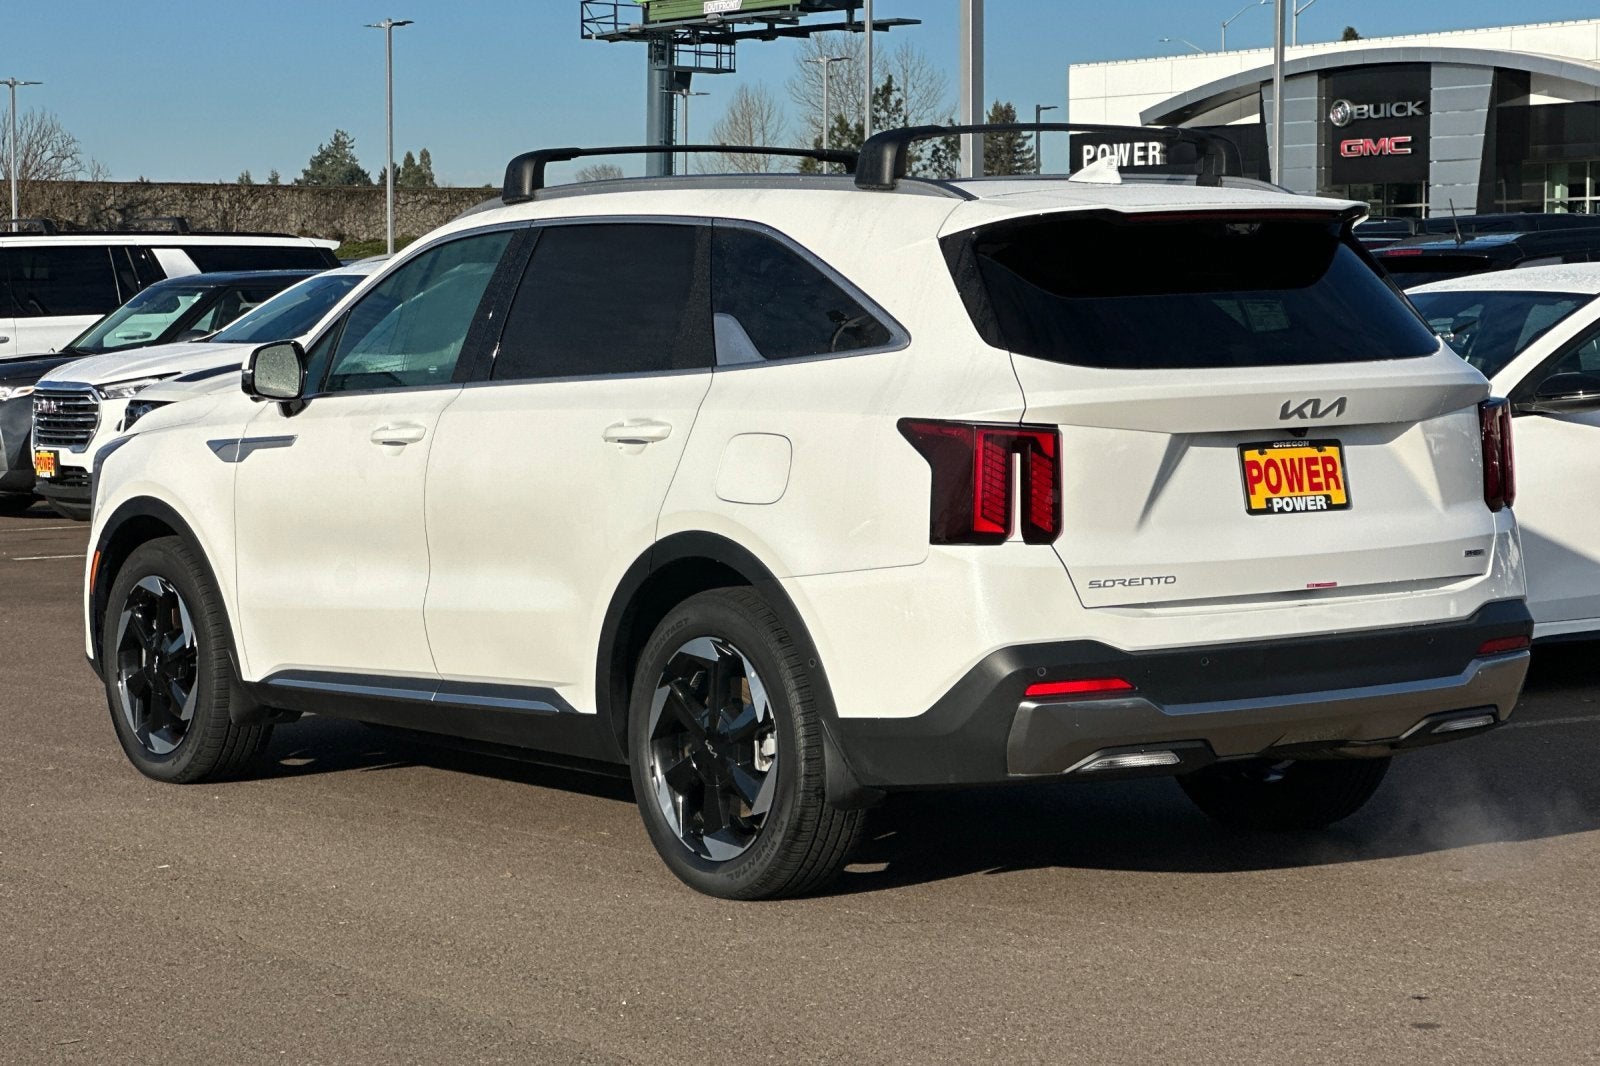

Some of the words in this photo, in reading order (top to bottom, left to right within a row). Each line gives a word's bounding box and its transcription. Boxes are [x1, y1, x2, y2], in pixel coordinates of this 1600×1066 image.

[1353, 101, 1424, 120] BUICK
[1083, 141, 1162, 168] POWER
[1341, 136, 1412, 157] GMC
[1279, 396, 1347, 420] KIA
[1273, 440, 1310, 448] OREGON
[35, 456, 55, 471] POWER
[1245, 455, 1342, 496] POWER
[1272, 495, 1328, 512] POWER
[1088, 575, 1177, 589] SORENTO
